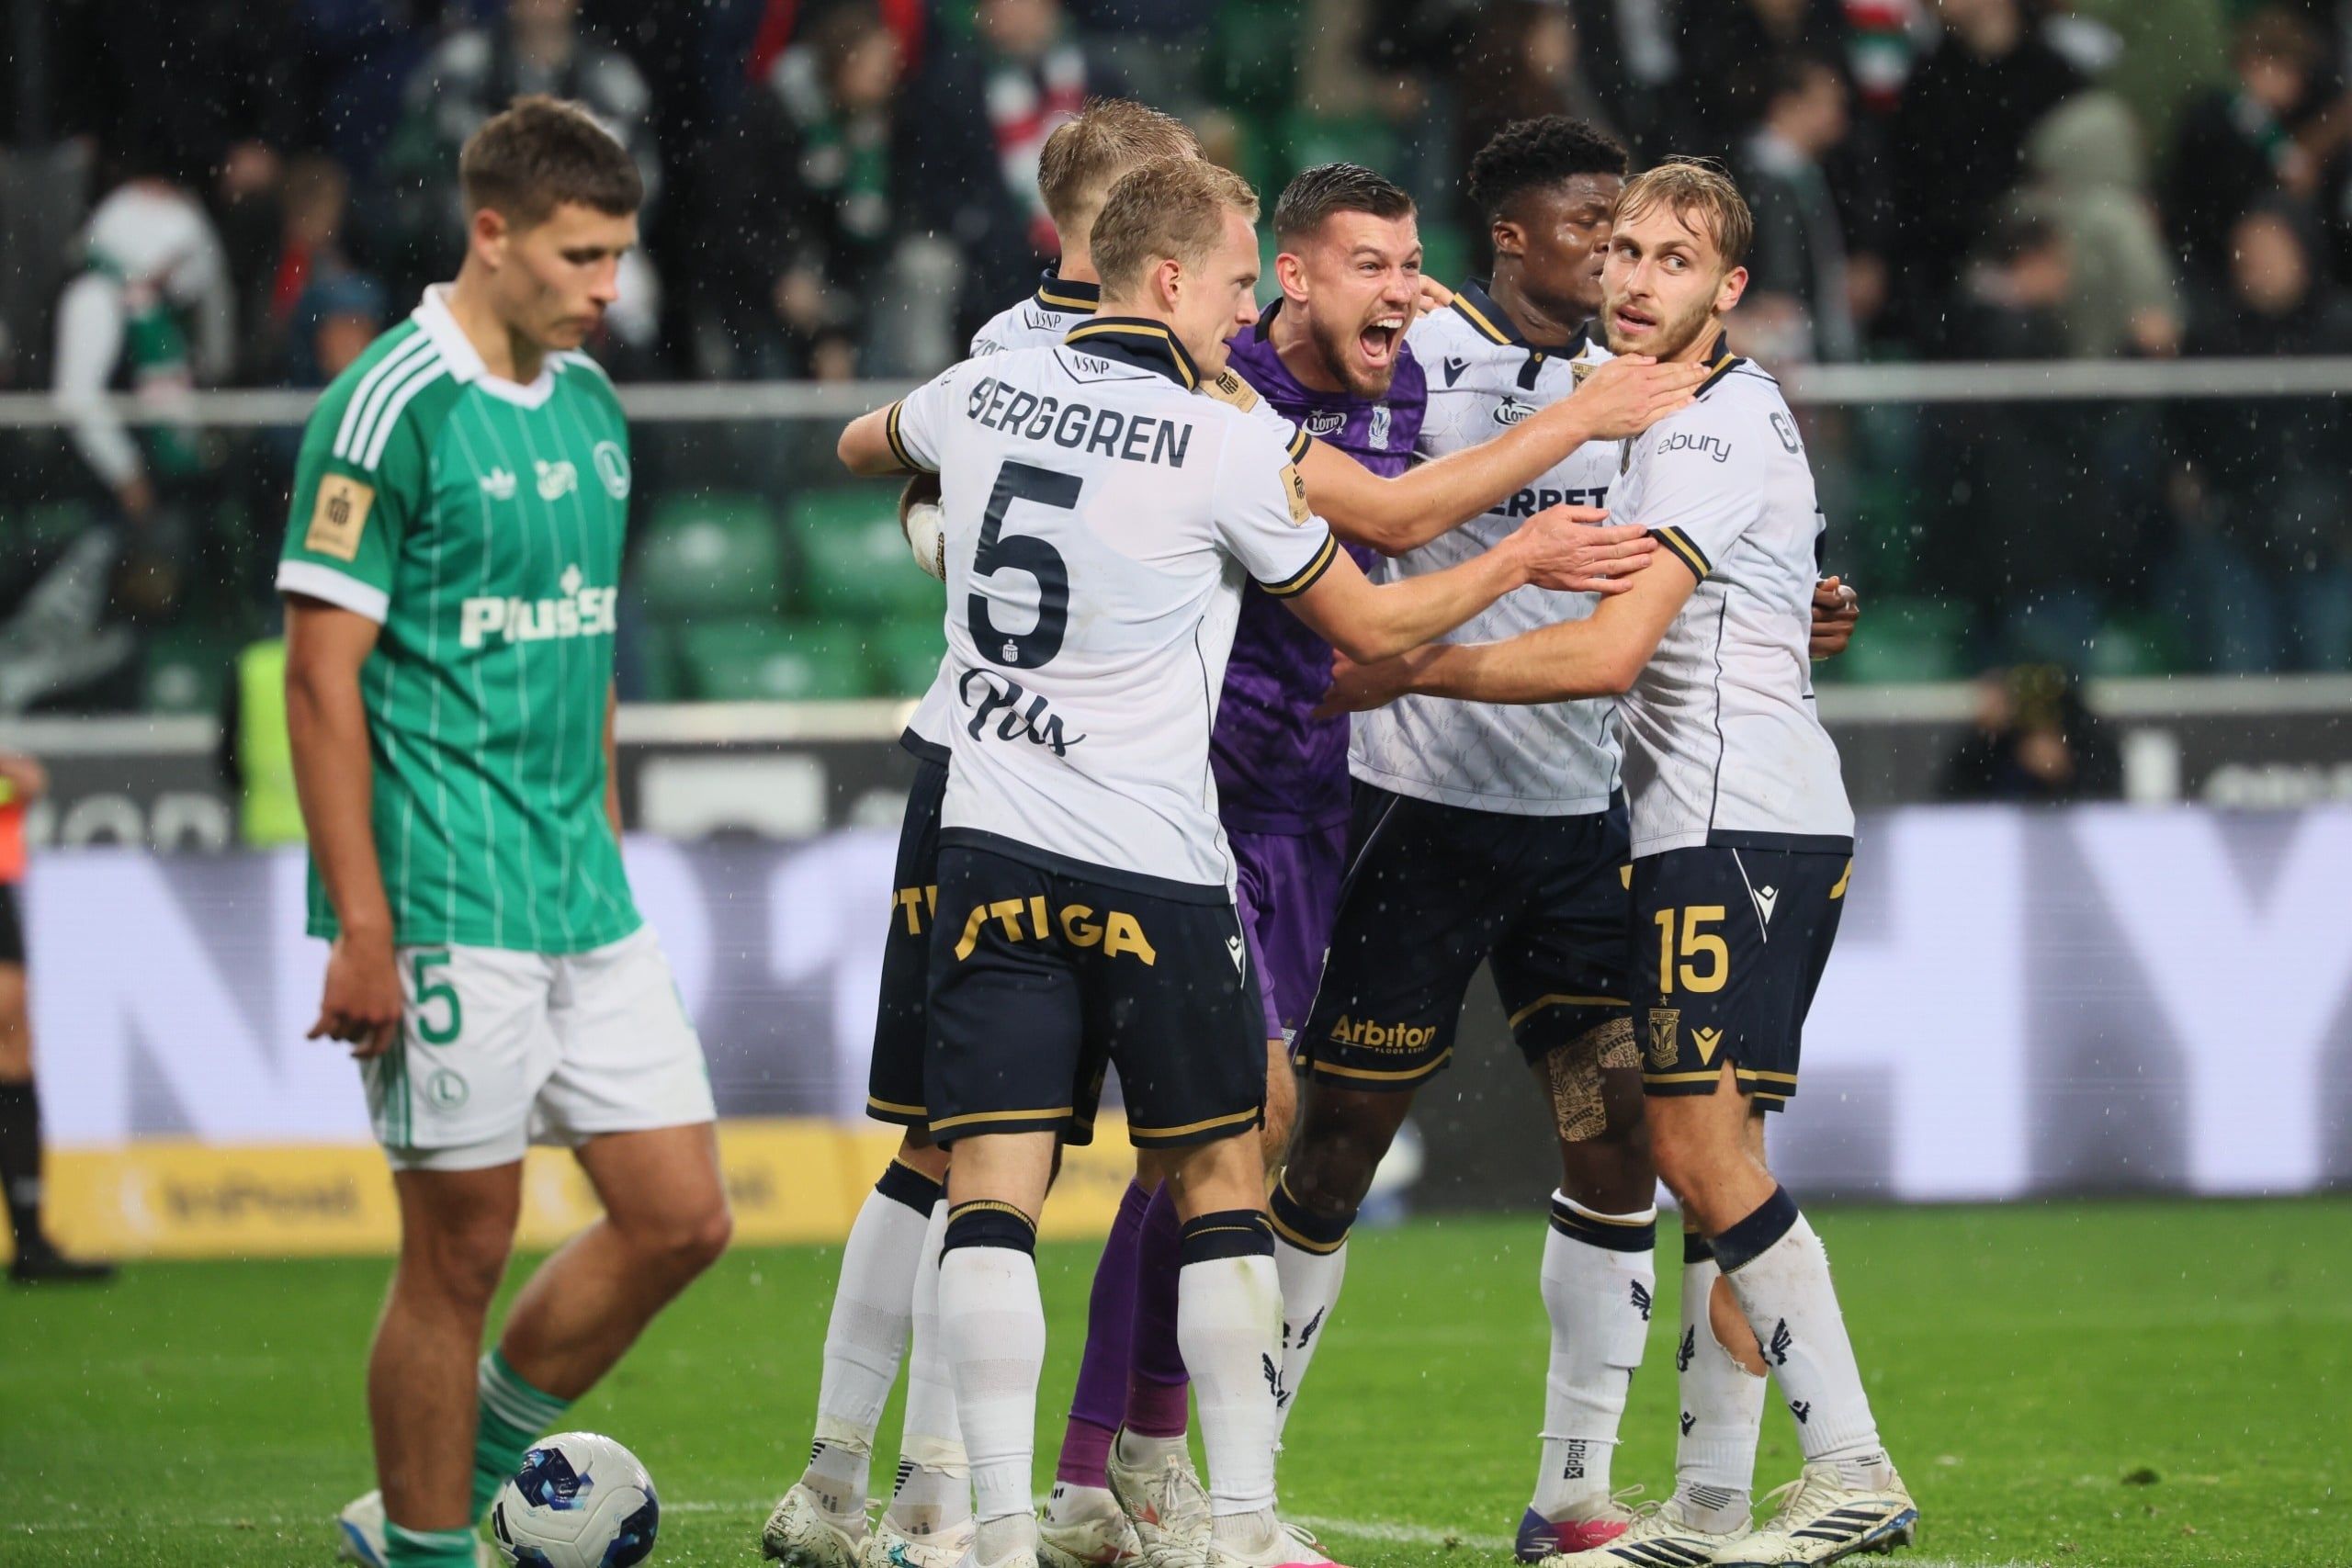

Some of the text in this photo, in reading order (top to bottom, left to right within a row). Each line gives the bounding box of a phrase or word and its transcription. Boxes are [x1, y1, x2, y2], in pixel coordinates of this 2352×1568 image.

[1033, 311, 1061, 328] NSNP
[1073, 355, 1110, 375] NSNP
[967, 377, 1193, 468] BERGGREN
[1657, 432, 1732, 463] ebury
[967, 460, 1083, 669] 5
[955, 896, 1157, 965] STIGA
[1654, 906, 1729, 993] 15
[414, 951, 462, 1045] 5
[1331, 1014, 1437, 1048] Arbiton
